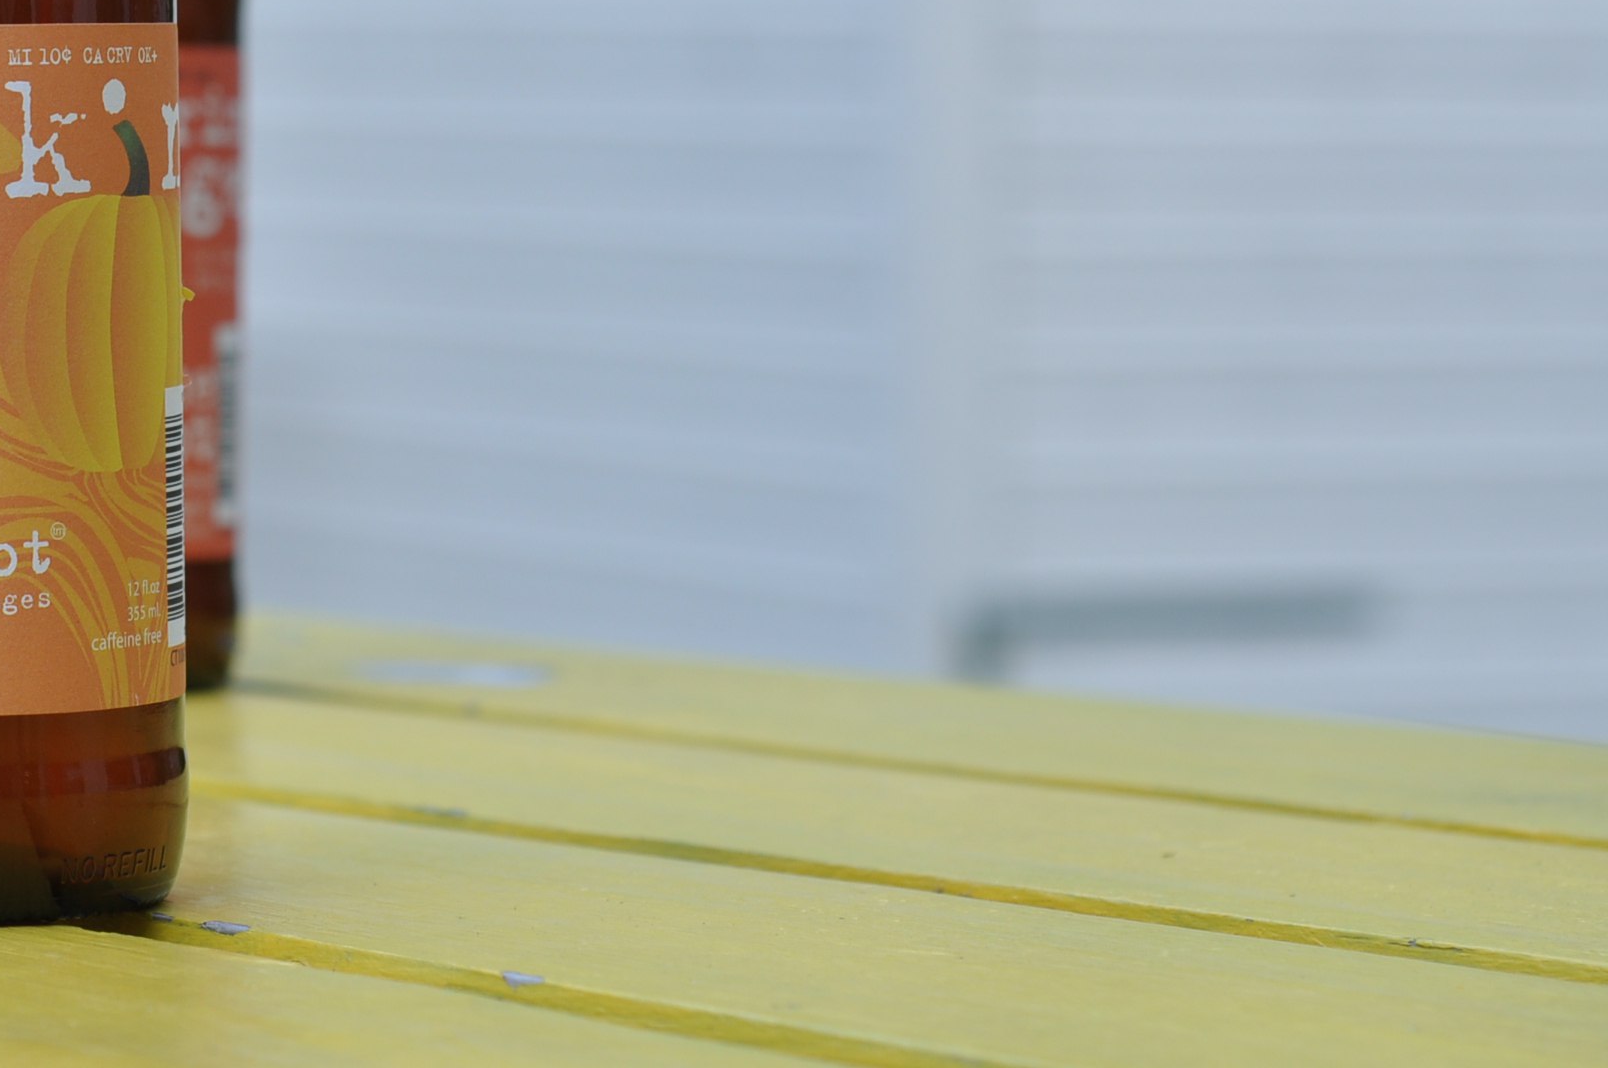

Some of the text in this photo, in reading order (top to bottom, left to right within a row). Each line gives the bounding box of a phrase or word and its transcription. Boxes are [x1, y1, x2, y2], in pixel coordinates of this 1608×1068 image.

[8, 48, 33, 66] MI
[83, 47, 103, 65] CA
[106, 46, 133, 64] CRV
[127, 580, 140, 597] 12
[127, 605, 146, 622] 355
[91, 627, 162, 651] caffeine free
